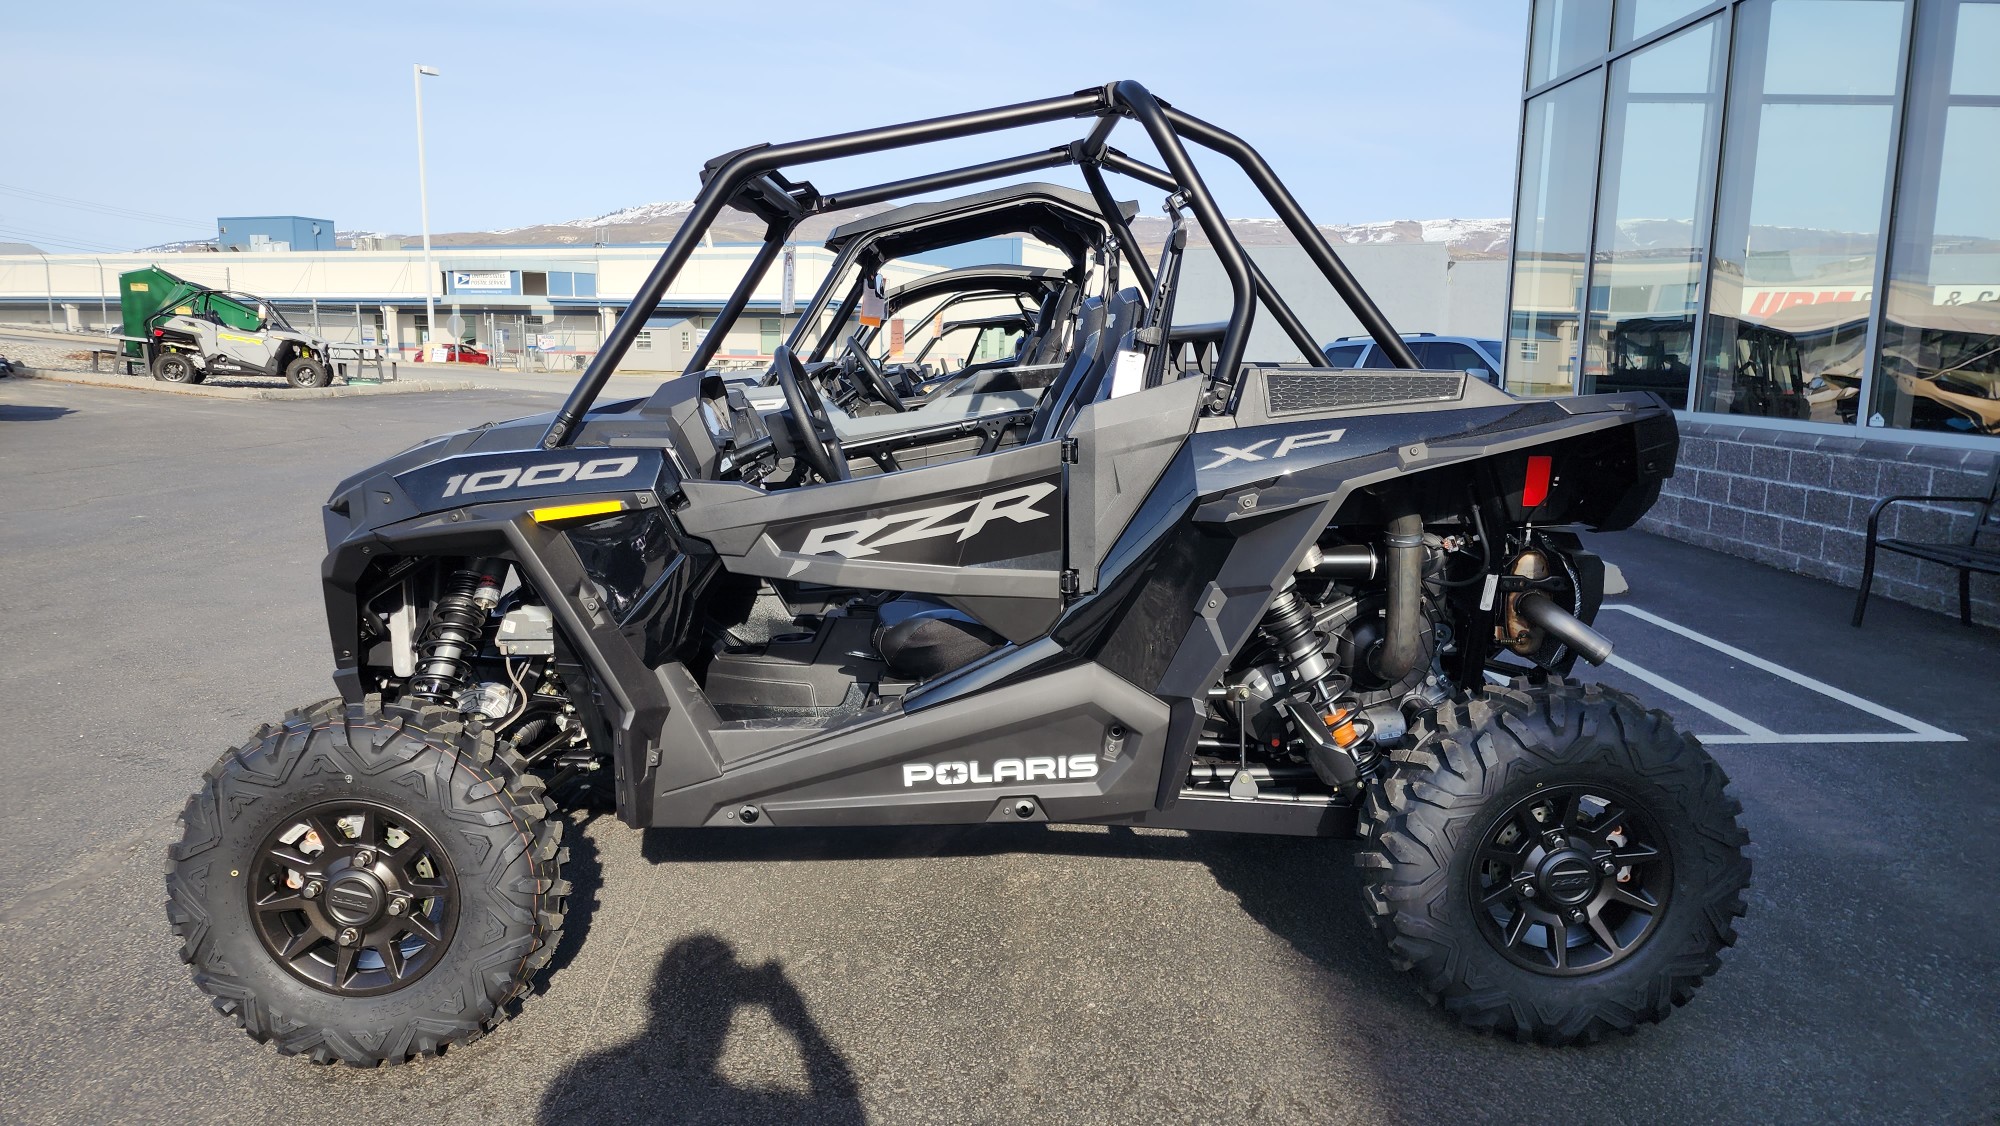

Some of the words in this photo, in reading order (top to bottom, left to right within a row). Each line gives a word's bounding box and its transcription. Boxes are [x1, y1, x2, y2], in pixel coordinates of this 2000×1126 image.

[1197, 428, 1347, 471] XP
[441, 456, 639, 498] 1000
[787, 481, 1058, 578] RZR
[903, 753, 1099, 787] POLARIS
